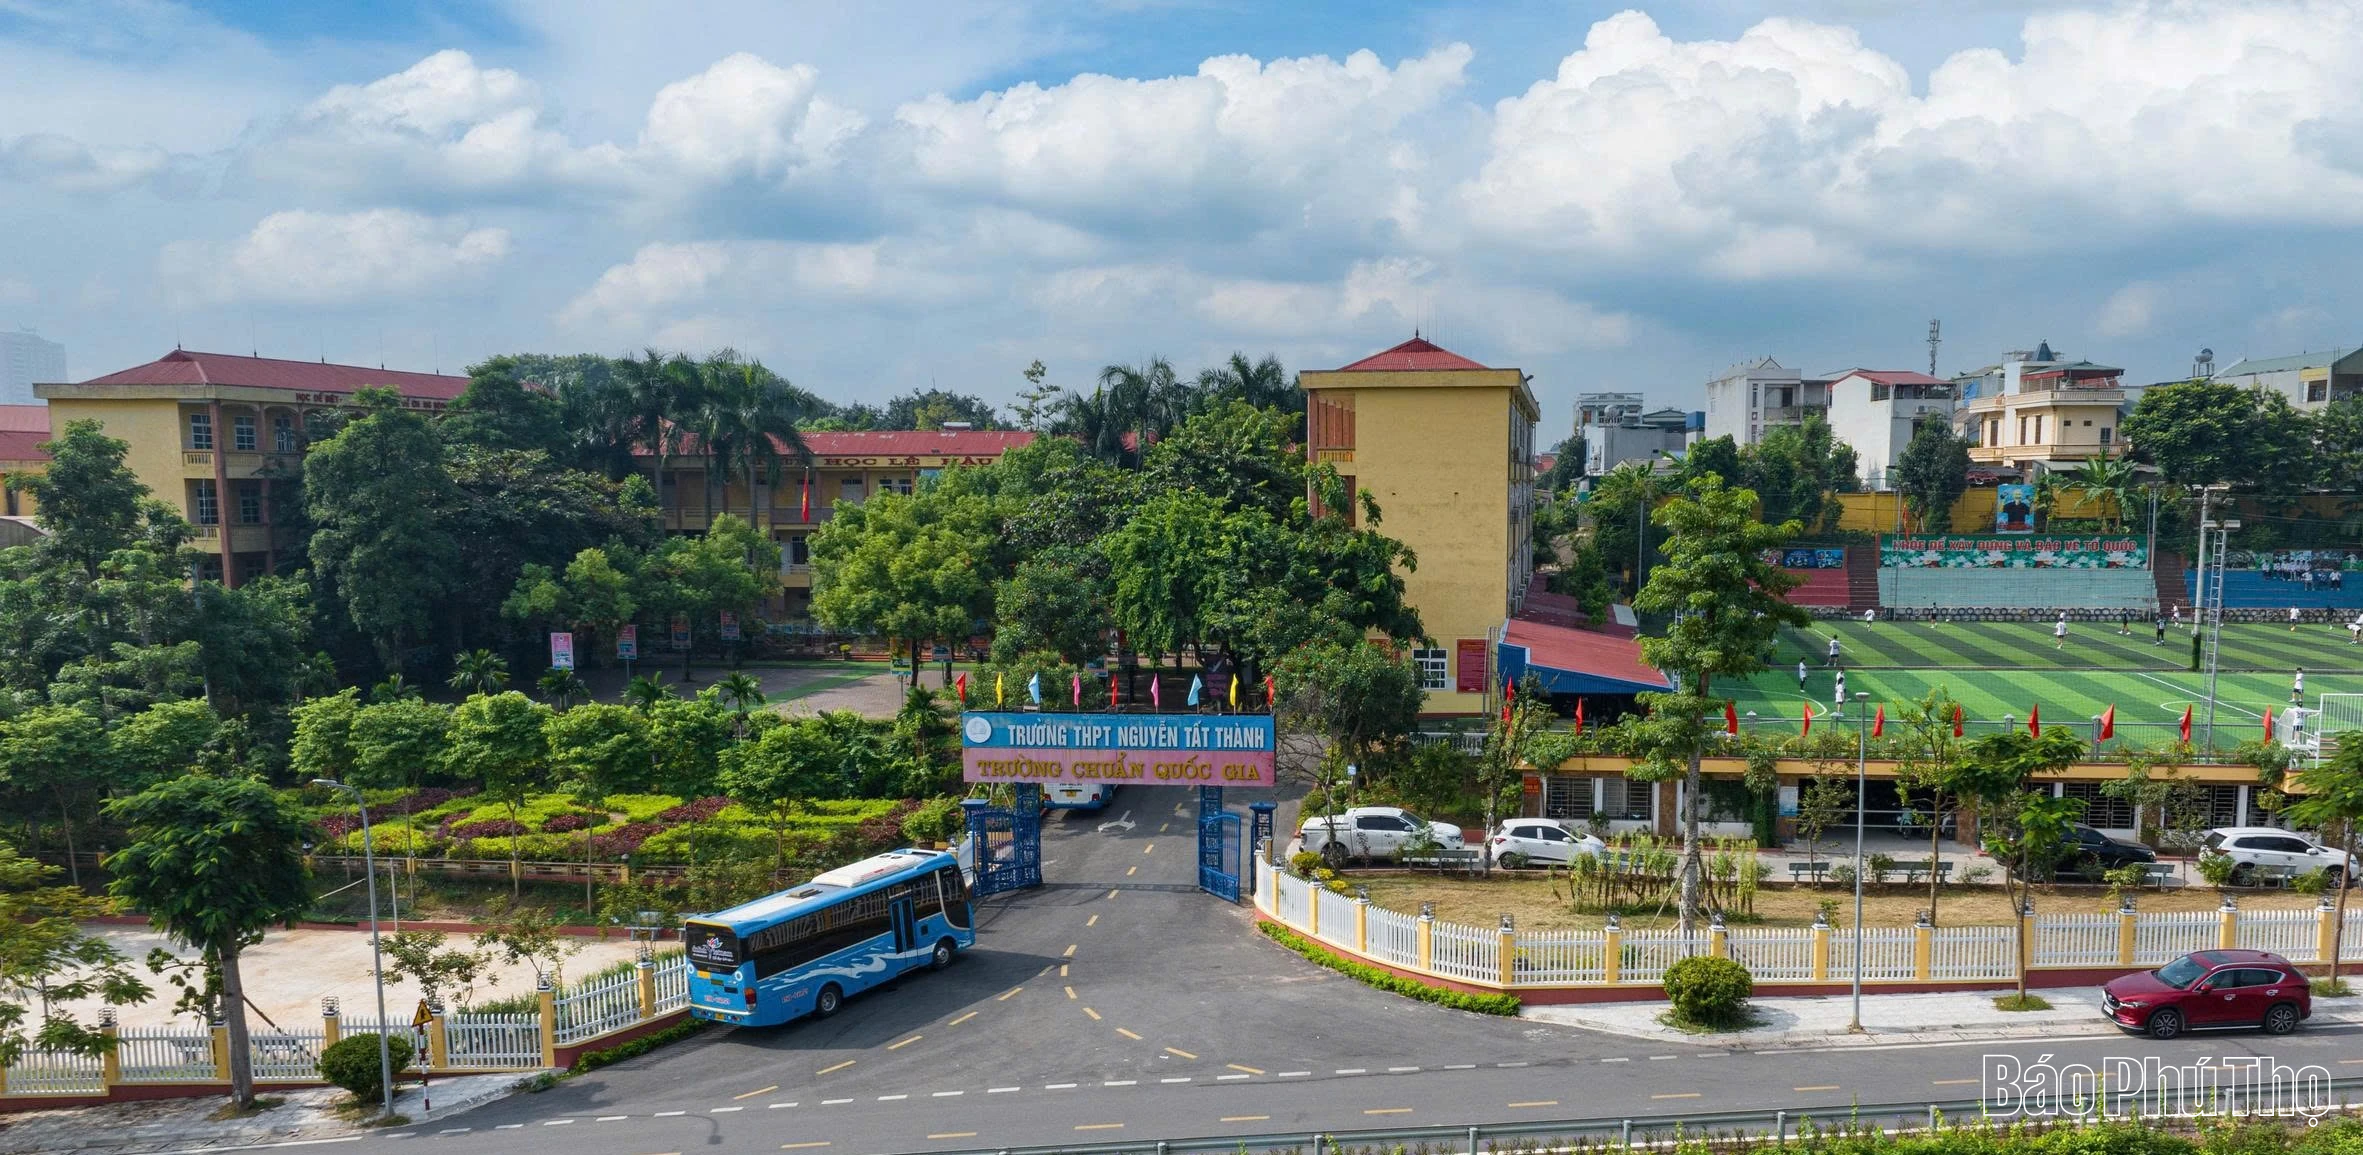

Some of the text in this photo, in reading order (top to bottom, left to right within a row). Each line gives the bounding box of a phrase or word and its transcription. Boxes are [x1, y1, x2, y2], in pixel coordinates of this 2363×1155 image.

[823, 458, 877, 468] HỌC
[1949, 537, 1974, 552] XÂY
[2016, 538, 2032, 553] VÀ
[1008, 717, 1264, 749] TRƯỜNG THPT NGUYỄN TẤT THÀNH
[976, 751, 1260, 781] TRƯỜNG CHUẨN QUỐC GIA
